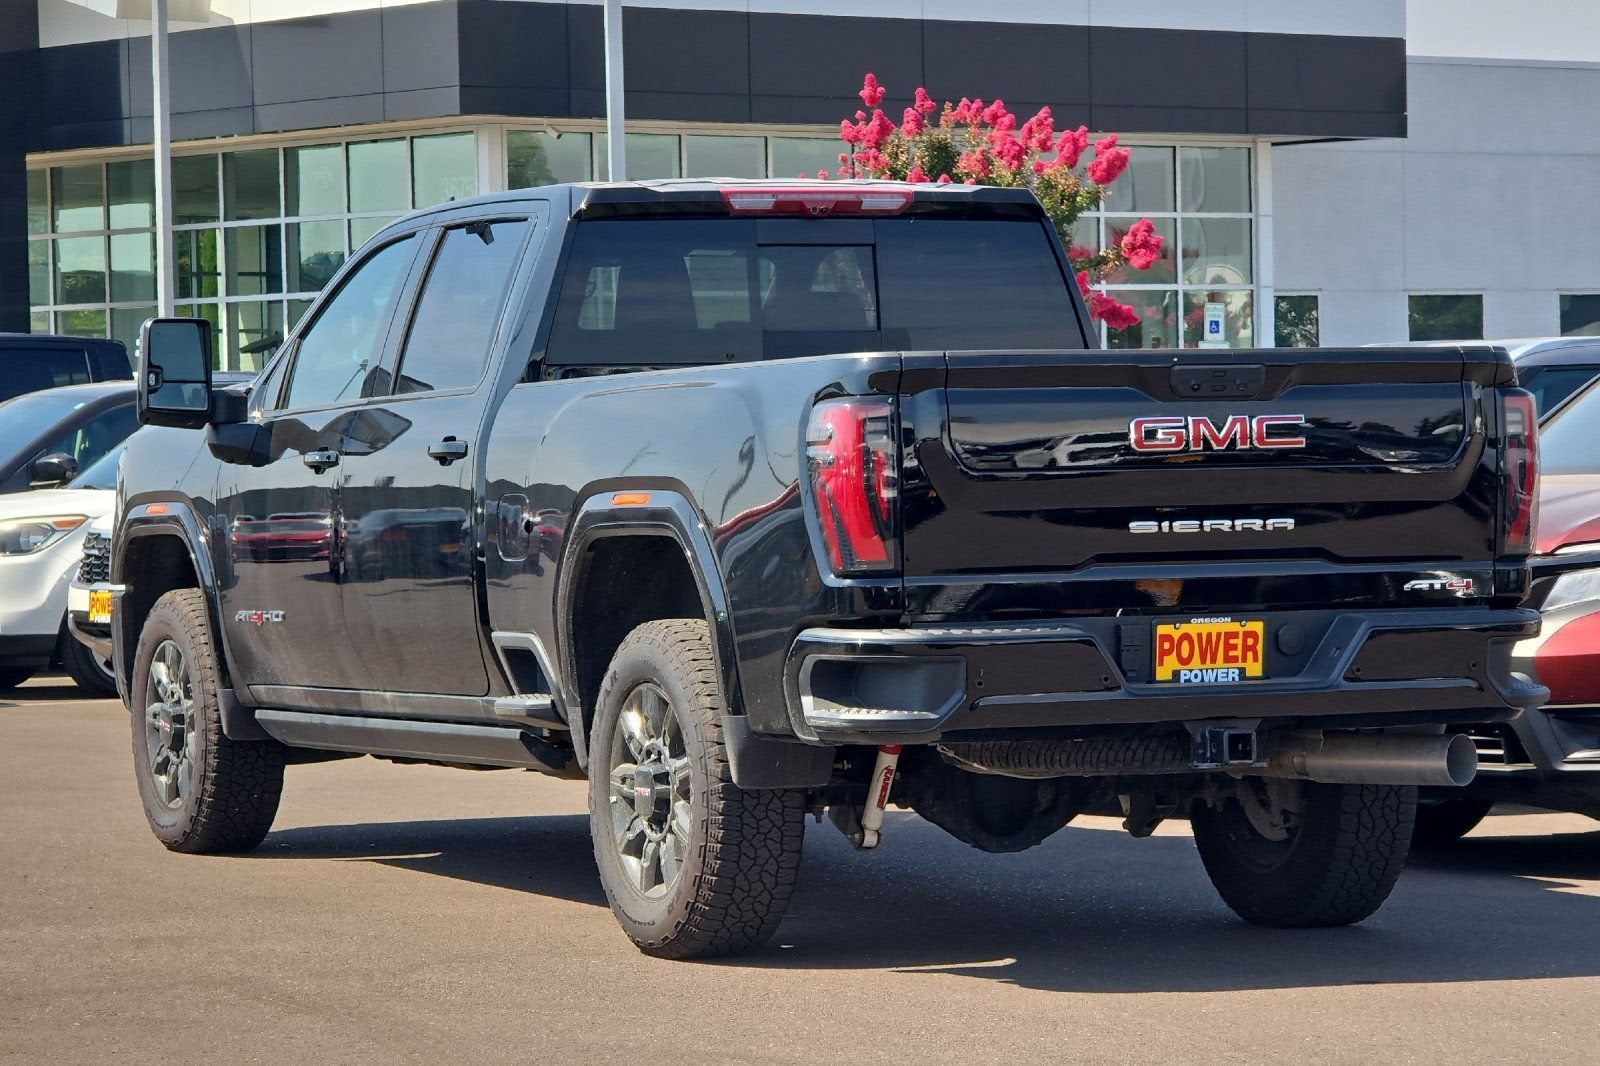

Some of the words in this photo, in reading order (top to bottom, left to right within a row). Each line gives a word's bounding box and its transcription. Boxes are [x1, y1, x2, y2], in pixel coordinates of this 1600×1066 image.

[1129, 414, 1306, 451] GMC
[1129, 518, 1295, 533] SIERRA
[1403, 578, 1473, 593] AT4
[91, 597, 112, 614] POWE
[1158, 630, 1259, 667] POWER
[1180, 668, 1240, 683] POWER
